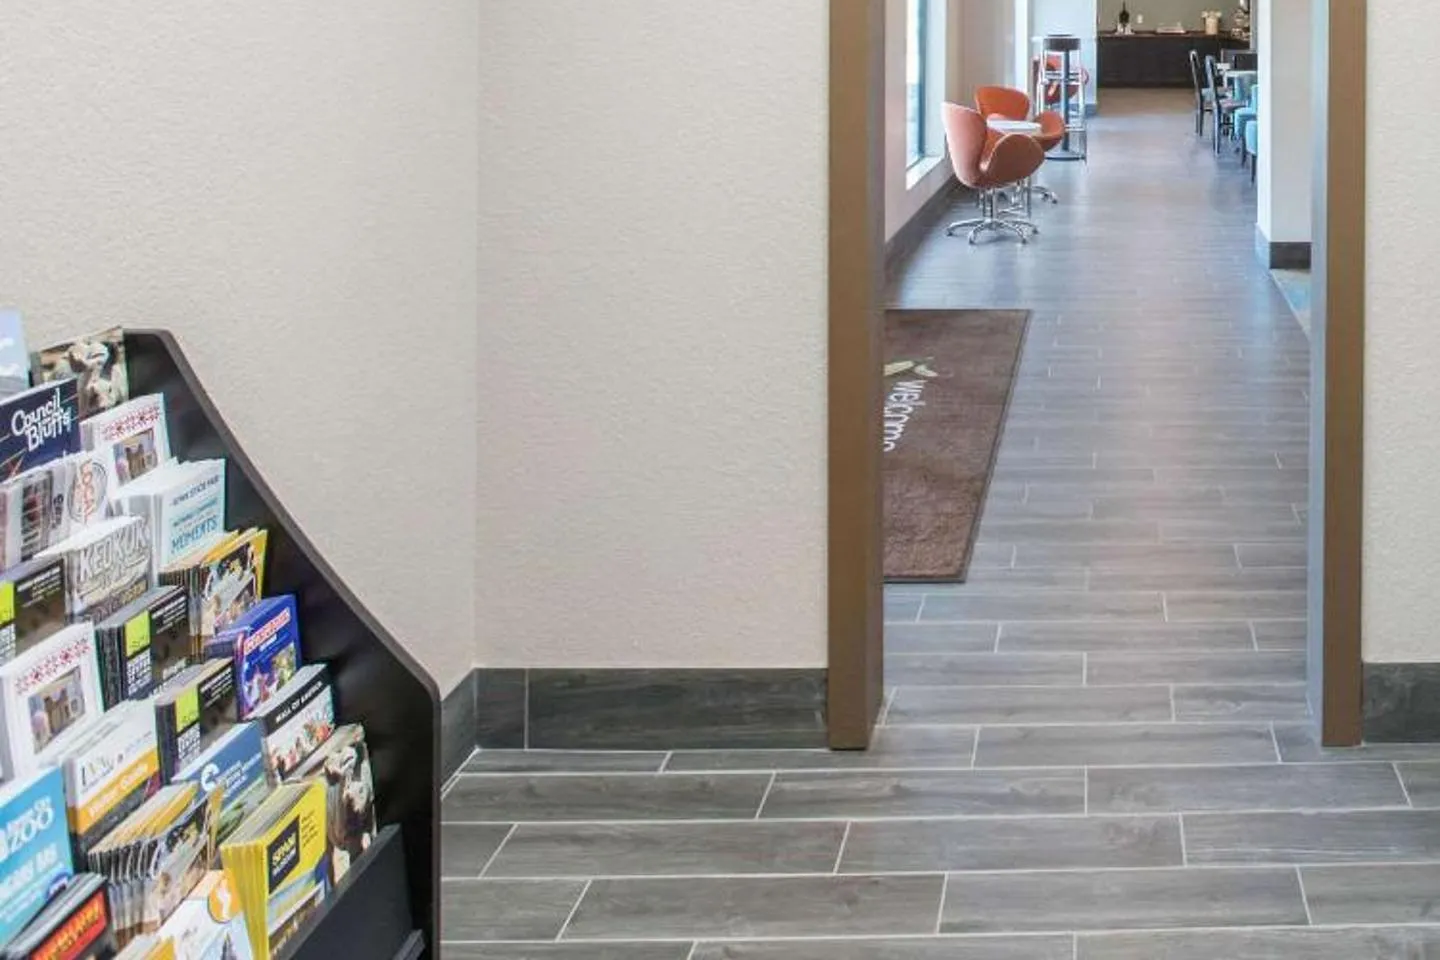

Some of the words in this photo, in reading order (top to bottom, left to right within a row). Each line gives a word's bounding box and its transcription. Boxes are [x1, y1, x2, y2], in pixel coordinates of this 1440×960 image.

[11, 387, 61, 437] Council
[25, 406, 72, 452] Bluffs
[79, 519, 151, 582] KEOKUK
